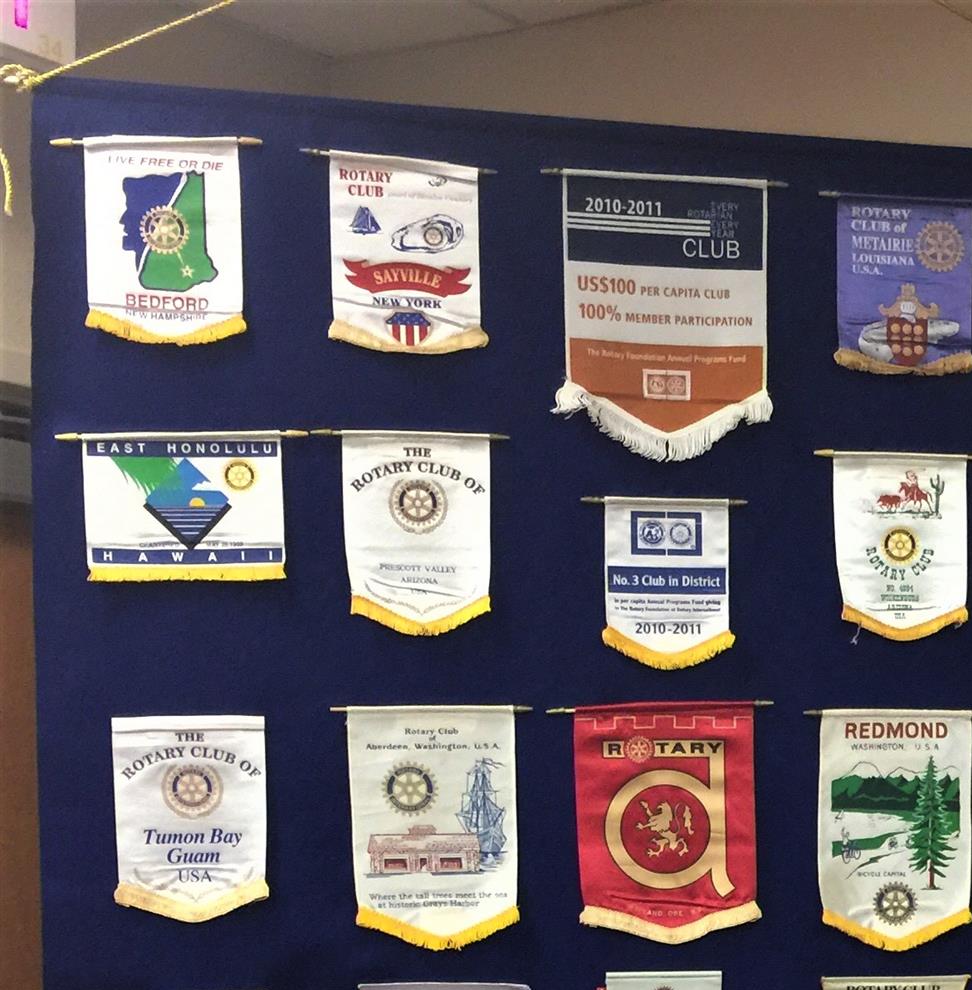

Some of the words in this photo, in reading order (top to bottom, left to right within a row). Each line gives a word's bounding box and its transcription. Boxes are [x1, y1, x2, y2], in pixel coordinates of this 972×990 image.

[140, 157, 175, 167] FREE
[179, 160, 200, 170] OR
[202, 161, 223, 171] DIE
[339, 168, 393, 183] ROTARY
[348, 184, 384, 198] CLUB
[585, 197, 662, 216] 2010-2011
[851, 207, 911, 220] ROTARY
[851, 220, 890, 233] CLUB
[894, 222, 907, 233] of
[683, 238, 741, 259] CLUB
[852, 236, 914, 252] METAIRIE
[852, 253, 915, 266] LOUISIANA
[373, 269, 442, 289] SAYVILLE
[577, 275, 636, 295] US$100
[640, 286, 660, 297] PER
[663, 287, 701, 299] CAPITA
[704, 289, 731, 299] CLUB
[126, 293, 209, 312] BEDFORD
[372, 297, 401, 307] NEW
[406, 298, 442, 309] YORK
[579, 302, 621, 322] 100%
[625, 312, 671, 325] MEMBER
[675, 315, 753, 327] PARTICIPATION
[96, 443, 145, 454] EAST
[167, 443, 273, 454] HONOLULU
[403, 447, 431, 458] THE
[350, 461, 414, 492] ROTARY
[418, 461, 461, 481] CLUB
[464, 476, 486, 496] OF
[103, 551, 273, 562] HAWAII
[866, 546, 906, 581] ROTARY
[379, 562, 421, 572] PRESCOTT
[424, 564, 457, 574] VALLEY
[400, 576, 439, 585] ARIZONA
[632, 575, 639, 585] 3
[641, 575, 666, 586] Club
[668, 575, 679, 586] in
[682, 575, 720, 587] District
[635, 622, 702, 635] 2010-2011
[175, 732, 205, 742] THE
[404, 728, 435, 736] Rotary
[845, 722, 948, 739] REDMOND
[120, 746, 186, 779] ROTARY
[190, 746, 236, 765] CLUB
[239, 760, 262, 778] OF
[144, 829, 204, 845] Tumon
[210, 828, 243, 847] Bay
[167, 848, 220, 864] Guam
[177, 869, 212, 882] USA
